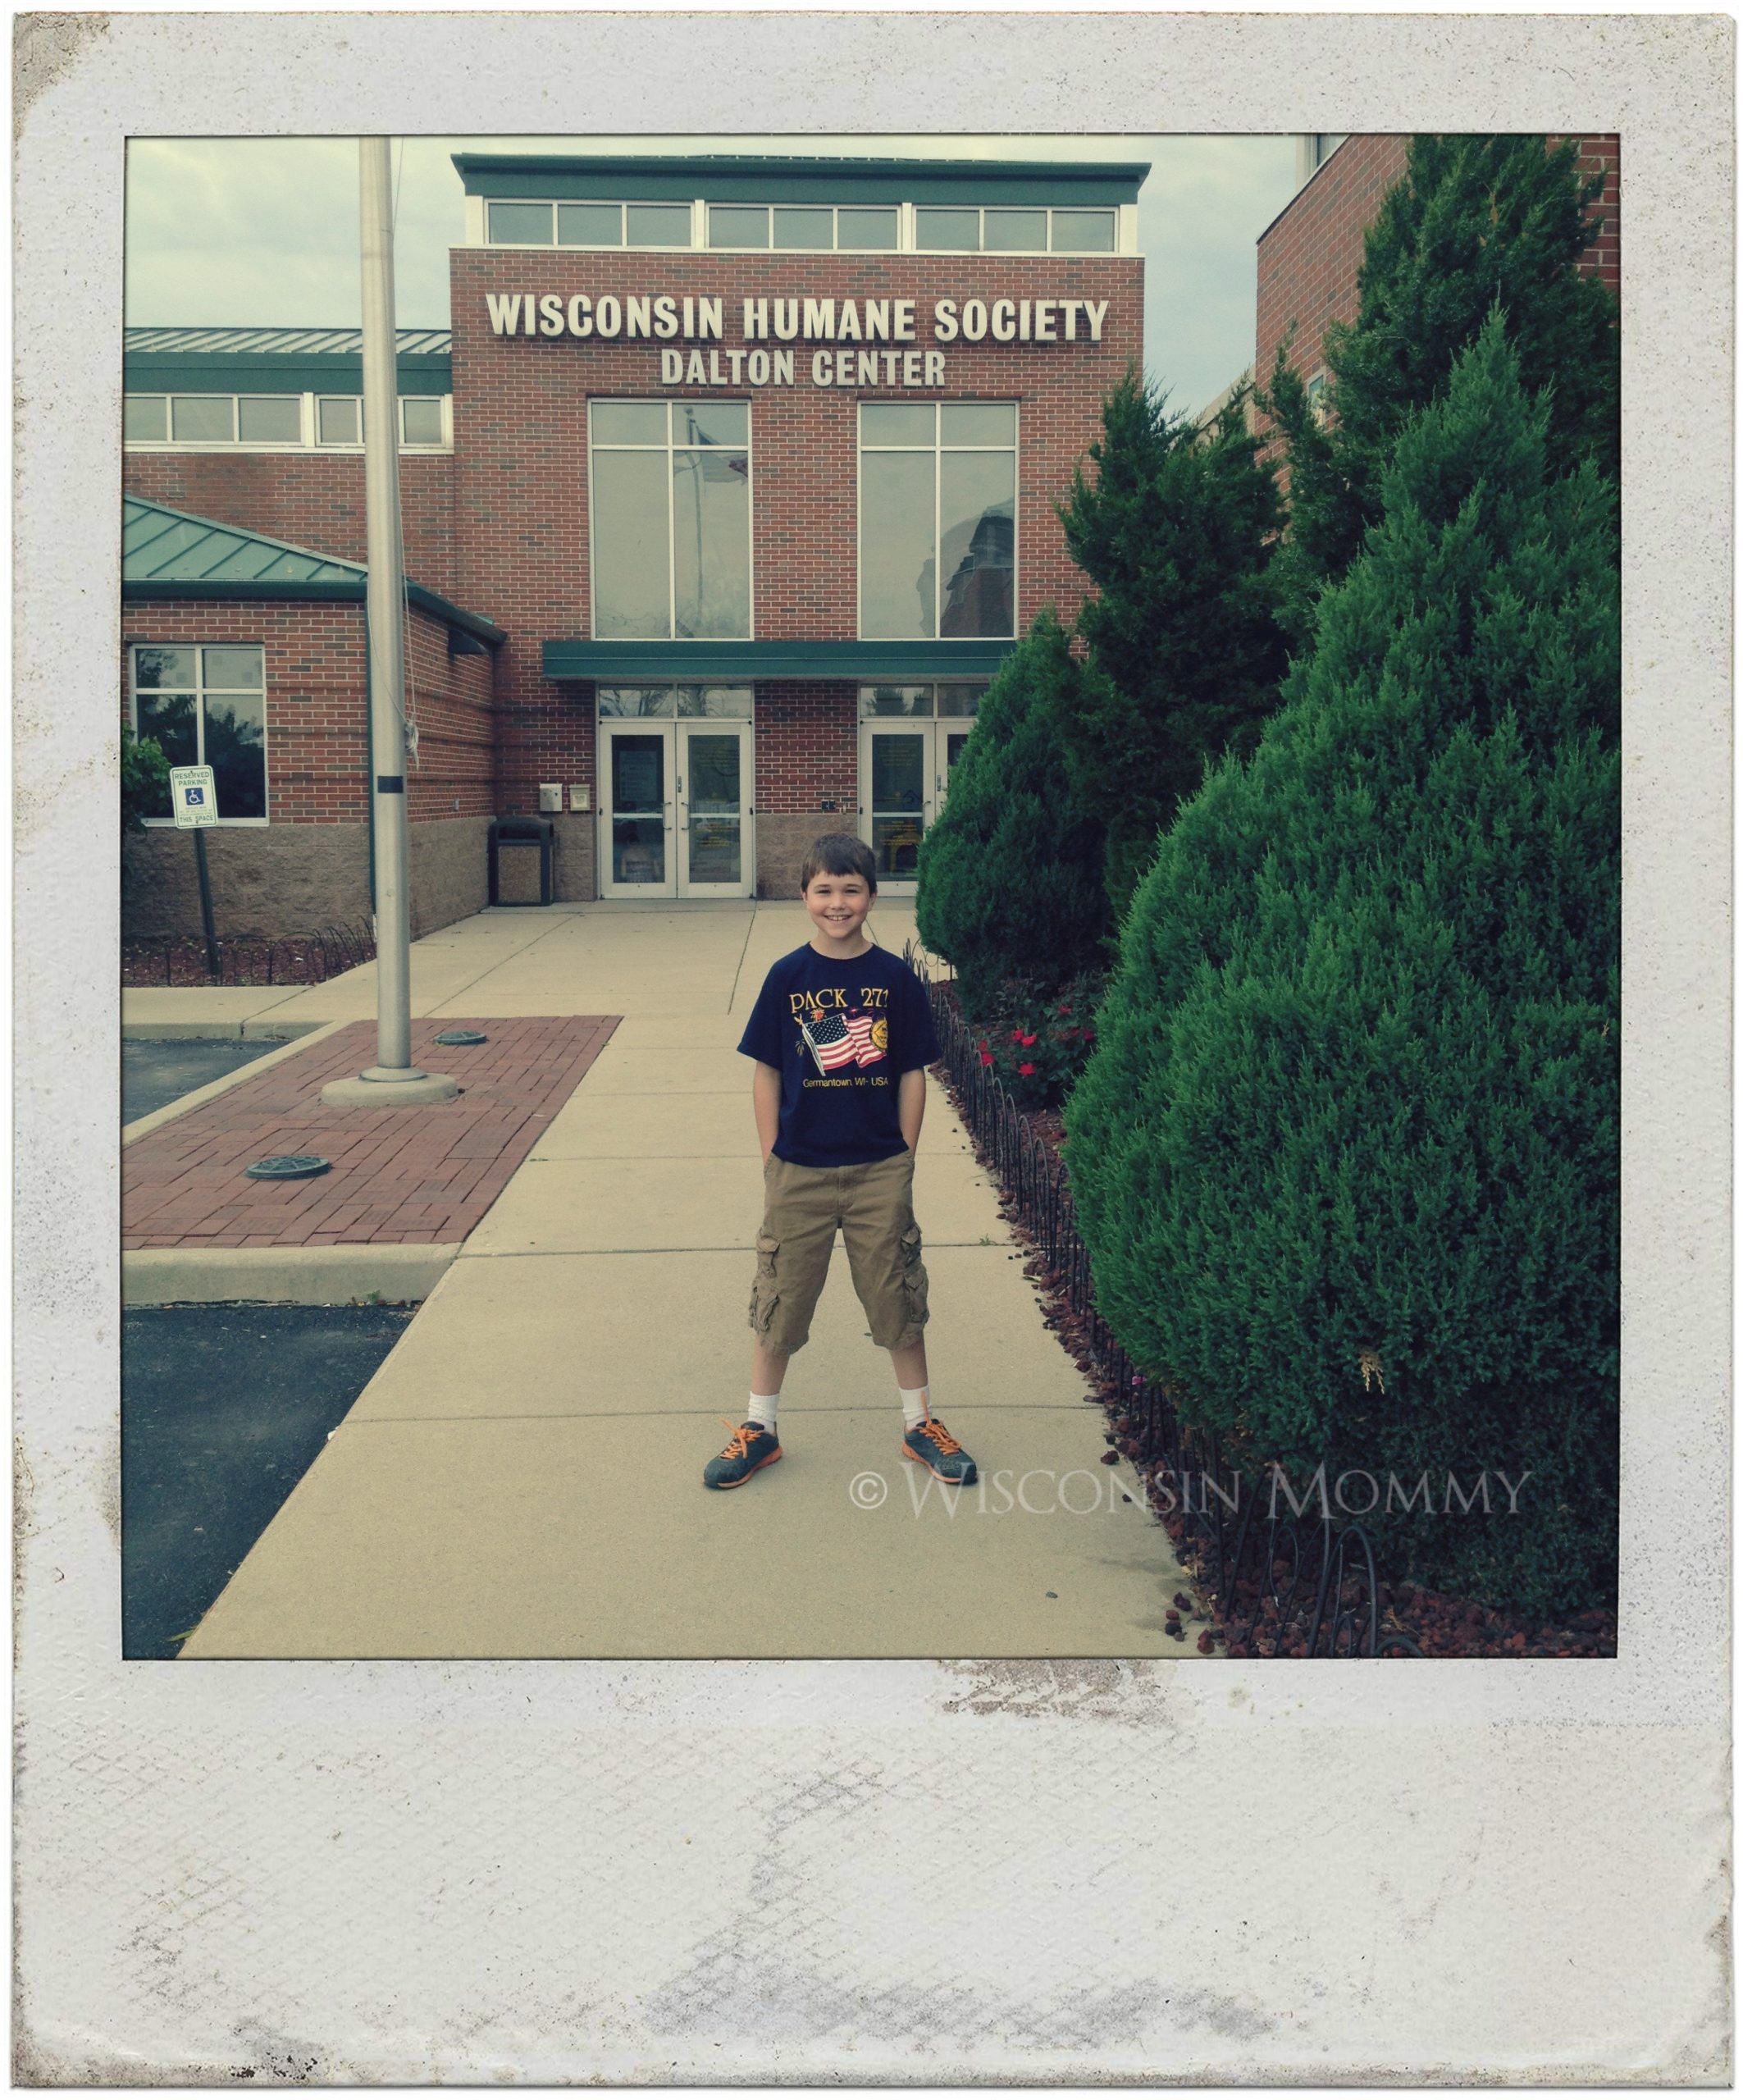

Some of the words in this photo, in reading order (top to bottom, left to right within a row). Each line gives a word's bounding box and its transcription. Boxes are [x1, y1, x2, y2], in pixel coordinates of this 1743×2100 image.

[486, 293, 723, 340] WISCONSIN
[743, 298, 916, 340] HUMANE
[934, 299, 1110, 341] SOCIETY
[661, 349, 795, 386] DALTON
[811, 350, 947, 387] CENTER
[789, 988, 848, 1013] PACK
[871, 1076, 888, 1086] USA
